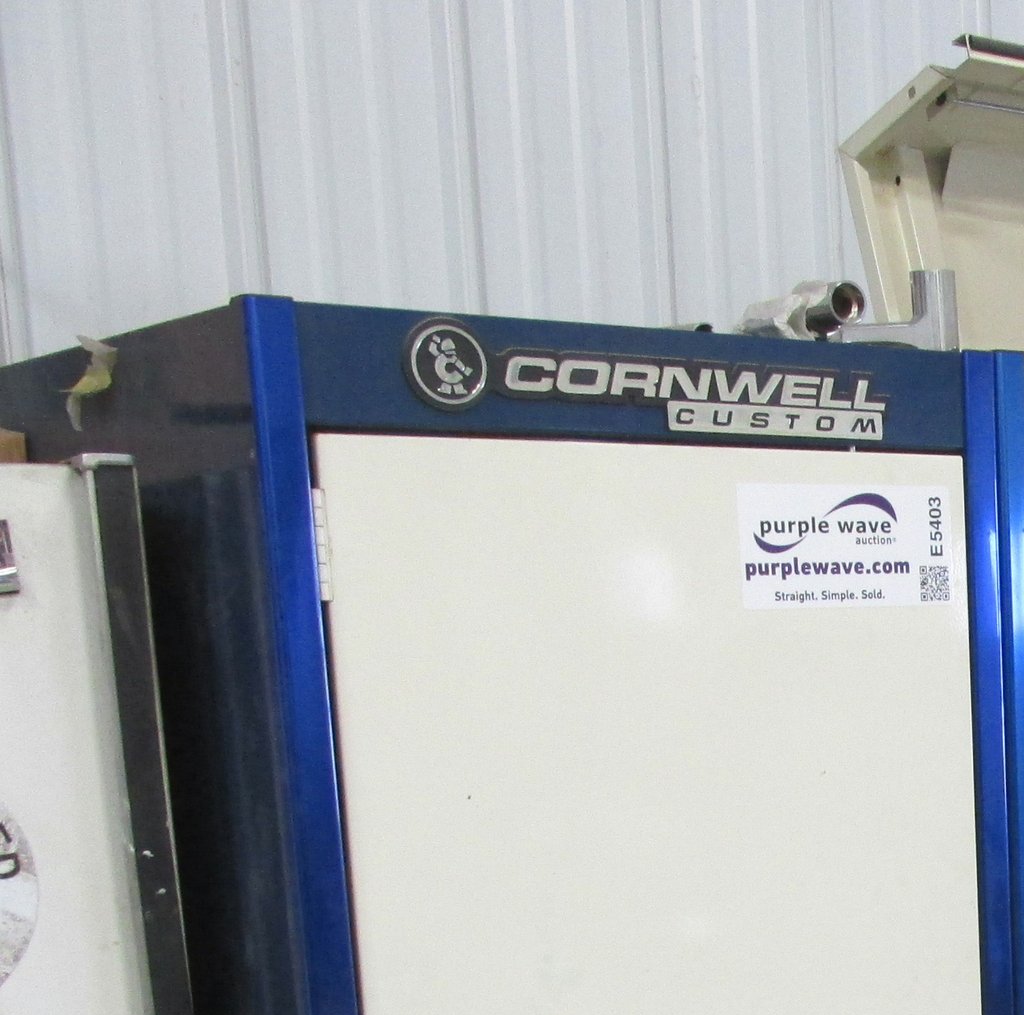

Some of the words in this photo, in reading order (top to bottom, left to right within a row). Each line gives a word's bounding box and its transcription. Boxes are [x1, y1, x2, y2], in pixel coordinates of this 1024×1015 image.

[505, 356, 886, 411] CORNWELL
[675, 407, 877, 434] CUSTOM
[760, 517, 829, 537] purple
[838, 519, 892, 533] wave
[745, 557, 910, 580] purplewave.com
[774, 590, 818, 603] Straight.
[821, 590, 858, 603] Simple.
[861, 589, 885, 600] Sold.
